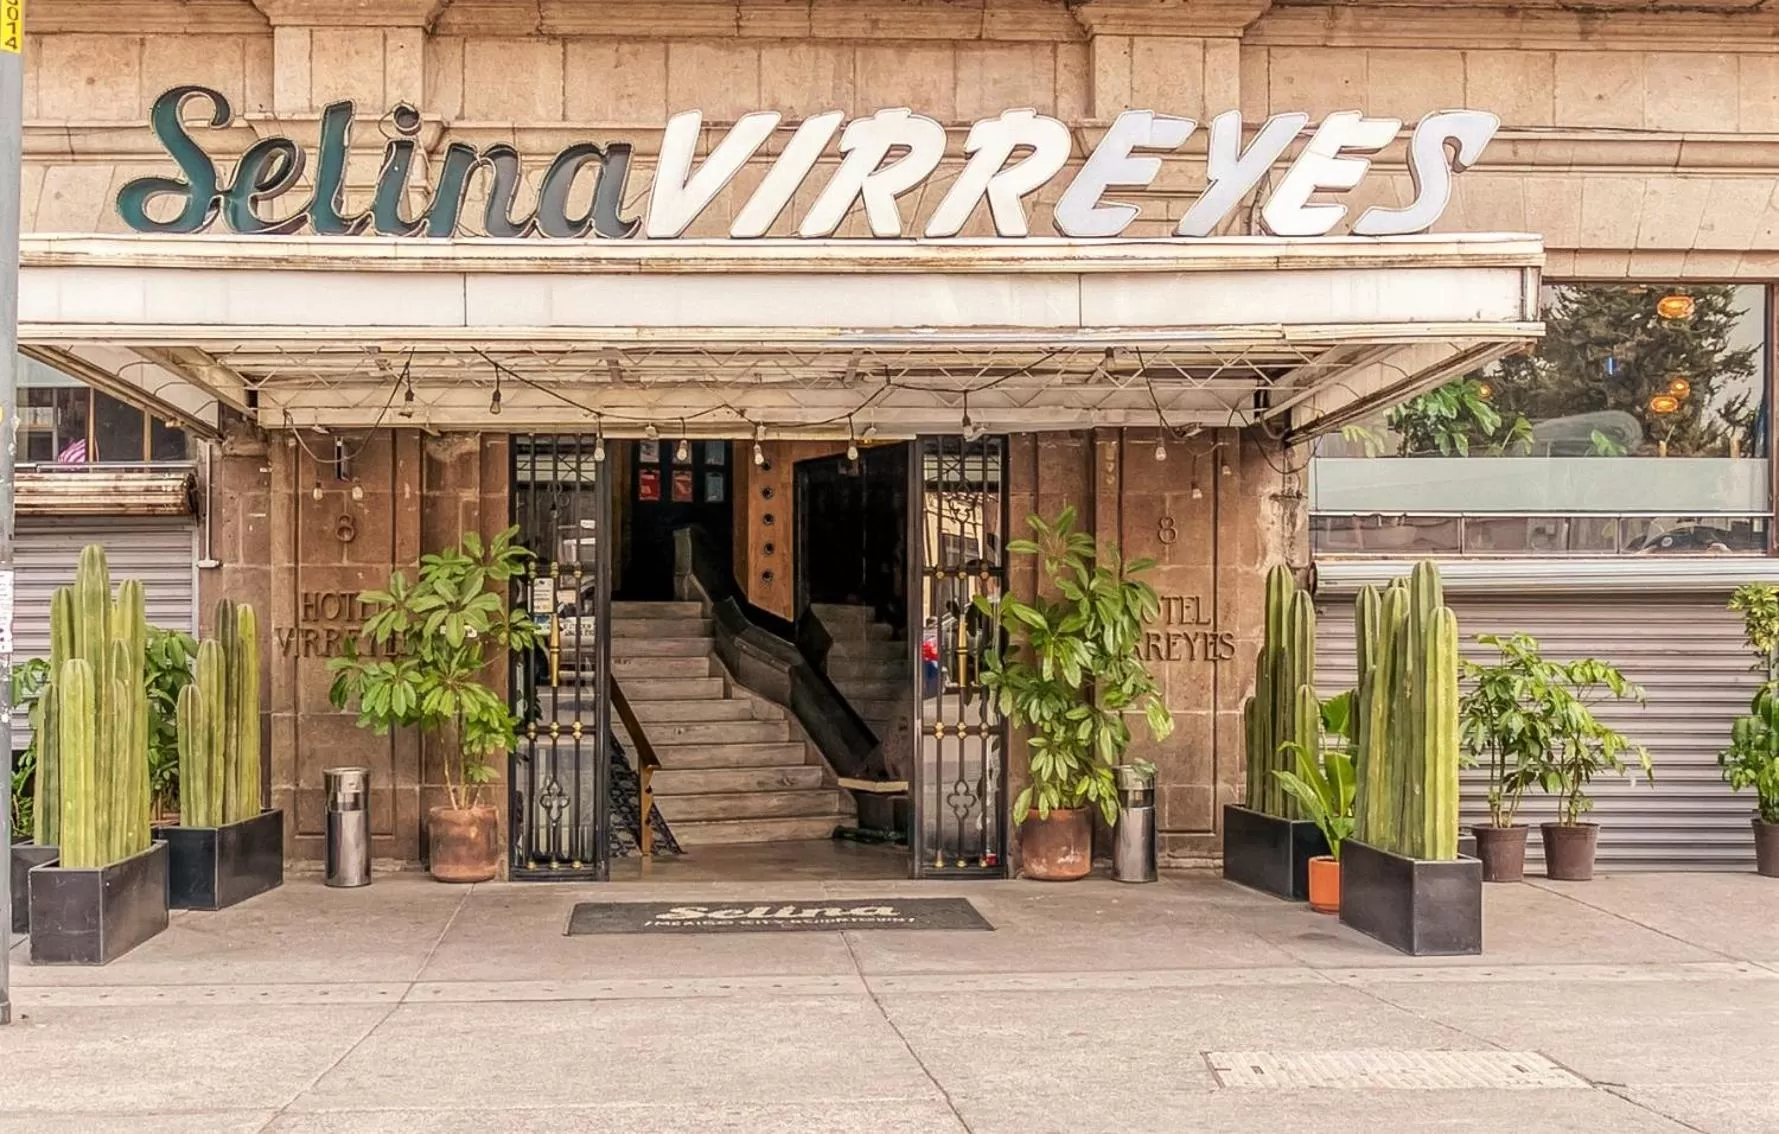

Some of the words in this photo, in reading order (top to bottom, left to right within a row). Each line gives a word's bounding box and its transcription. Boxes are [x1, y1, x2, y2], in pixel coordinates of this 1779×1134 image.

[115, 85, 642, 238] Selina
[647, 107, 1500, 239] VIRREYES
[335, 514, 355, 542] 8
[1158, 516, 1177, 544] 8
[1141, 596, 1211, 625] OTEL
[1133, 631, 1236, 661] REYES
[656, 906, 900, 920] Selina
